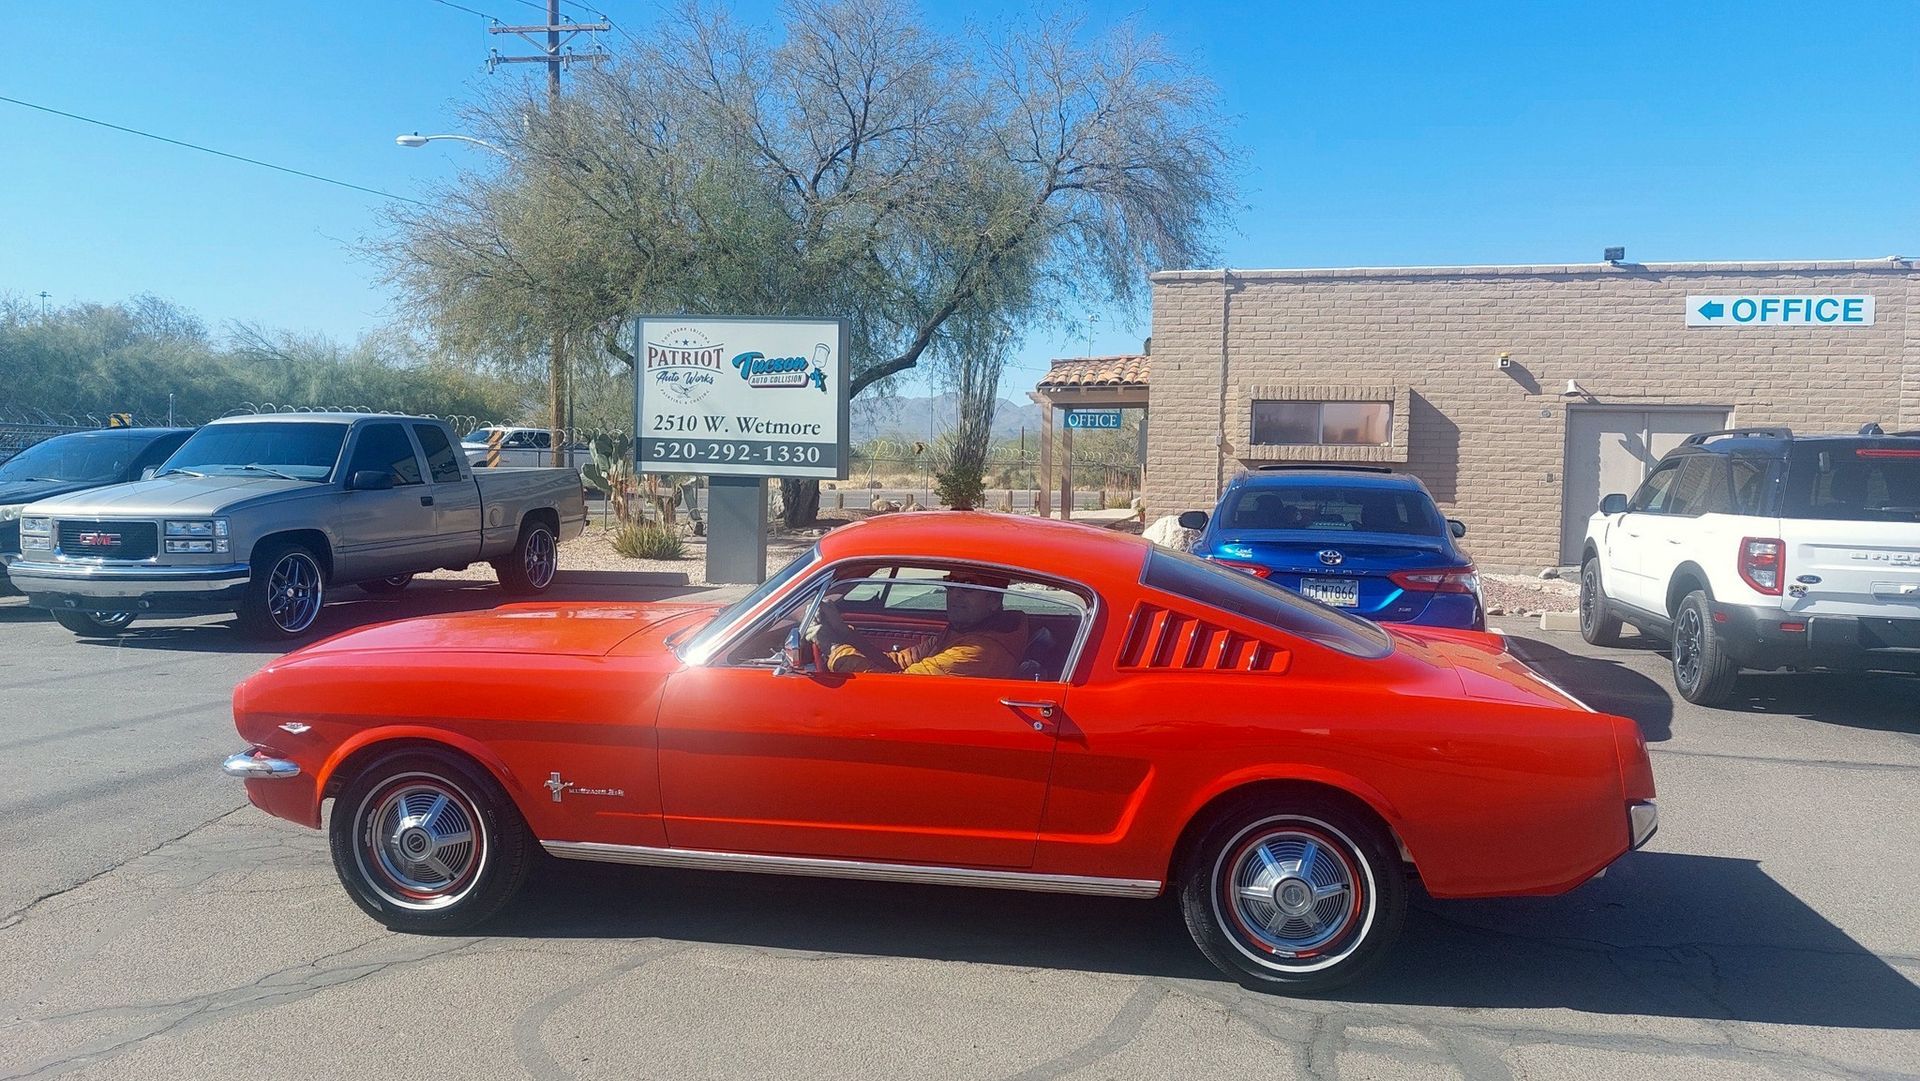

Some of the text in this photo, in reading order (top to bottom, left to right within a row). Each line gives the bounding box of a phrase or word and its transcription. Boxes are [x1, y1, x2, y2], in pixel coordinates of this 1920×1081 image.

[1732, 298, 1864, 322] OFFICE
[648, 346, 724, 369] PATRIOT
[732, 352, 809, 380] Tucson
[656, 371, 714, 386] Auto Works
[770, 375, 802, 383] COLLISION
[653, 415, 821, 435] 2510 W. Wetmore
[1068, 414, 1117, 427] OFFICE
[653, 442, 820, 463] 520-292-1330
[80, 533, 121, 546] GMC
